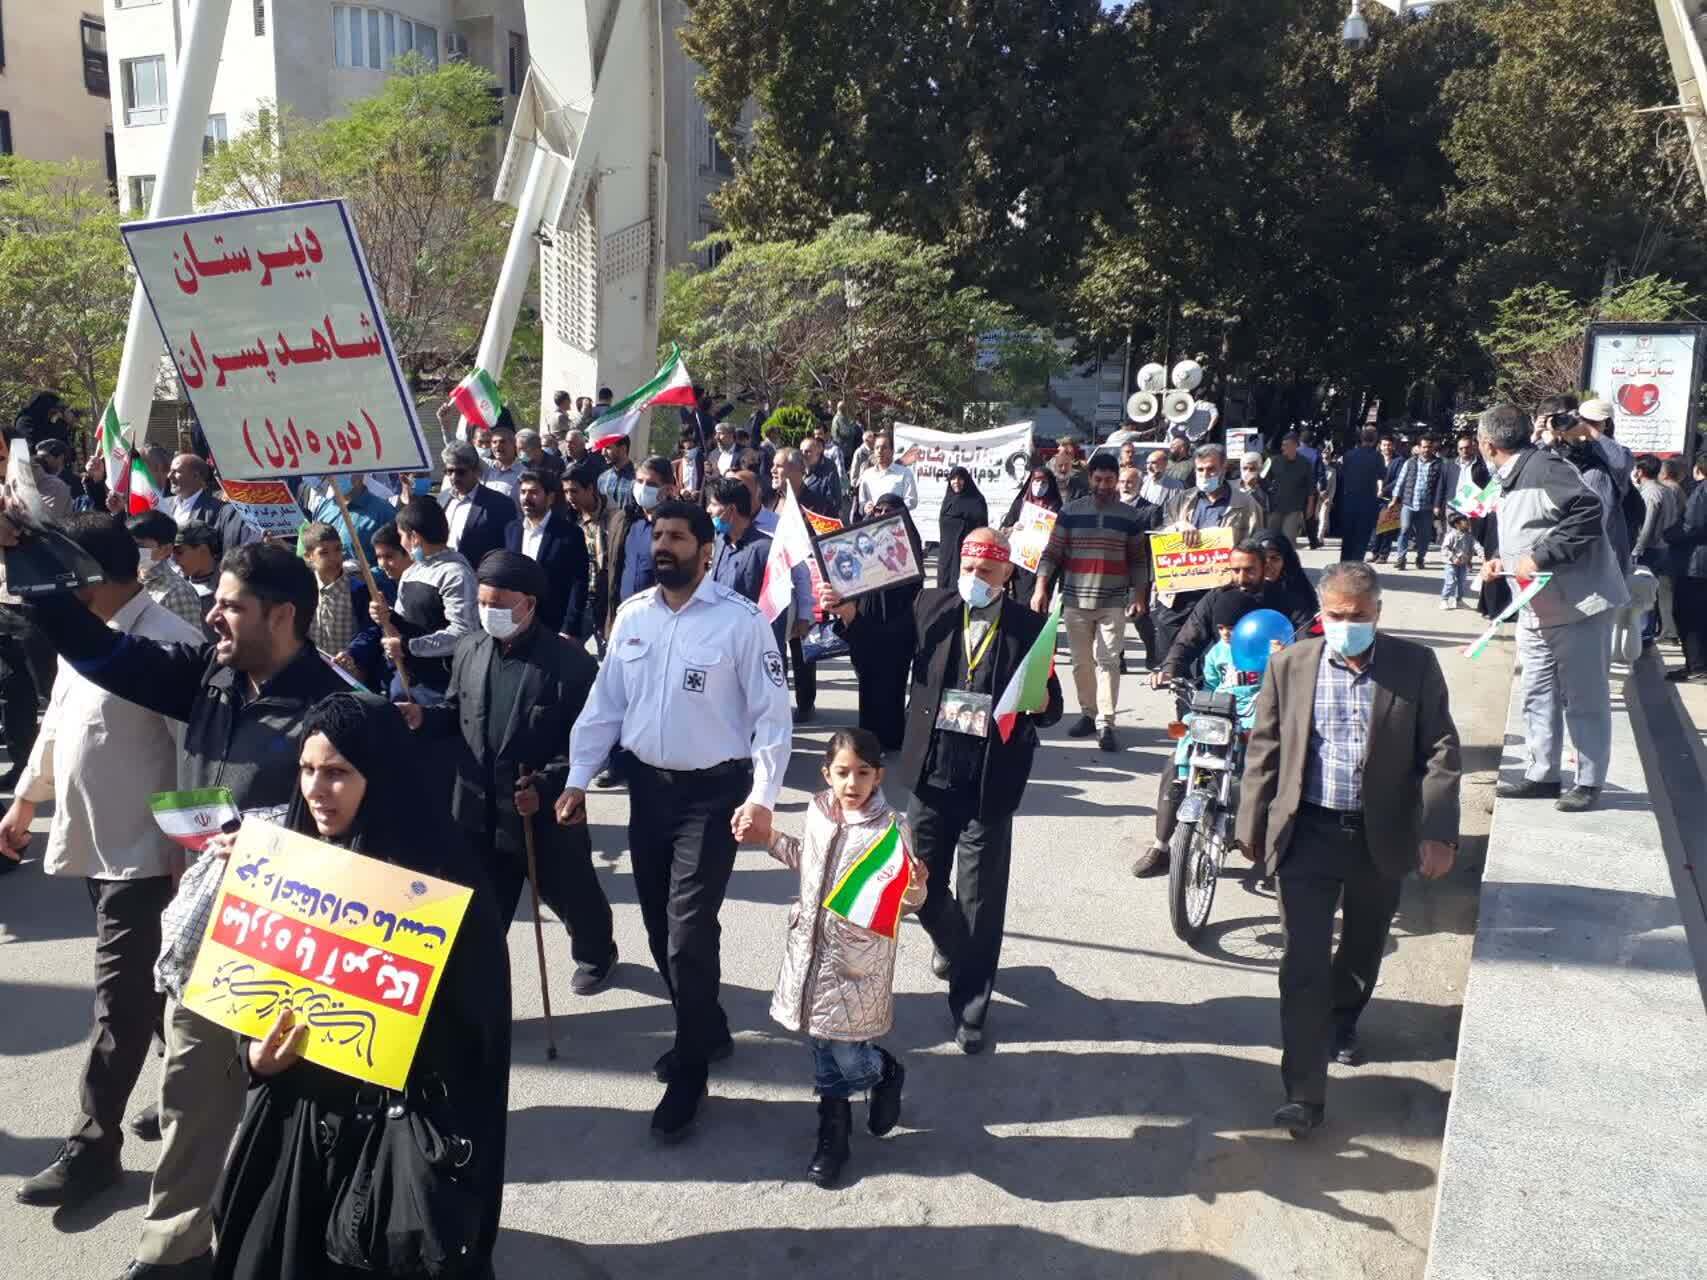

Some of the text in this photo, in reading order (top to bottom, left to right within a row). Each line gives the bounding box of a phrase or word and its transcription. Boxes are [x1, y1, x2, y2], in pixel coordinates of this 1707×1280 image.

[173, 227, 324, 295] دبیرستان
[178, 312, 382, 389] شاهد پسران
[271, 875, 369, 926] اعتقادات
[374, 909, 447, 950] ماست
[222, 902, 420, 1007] مبارزه با آمریکا
